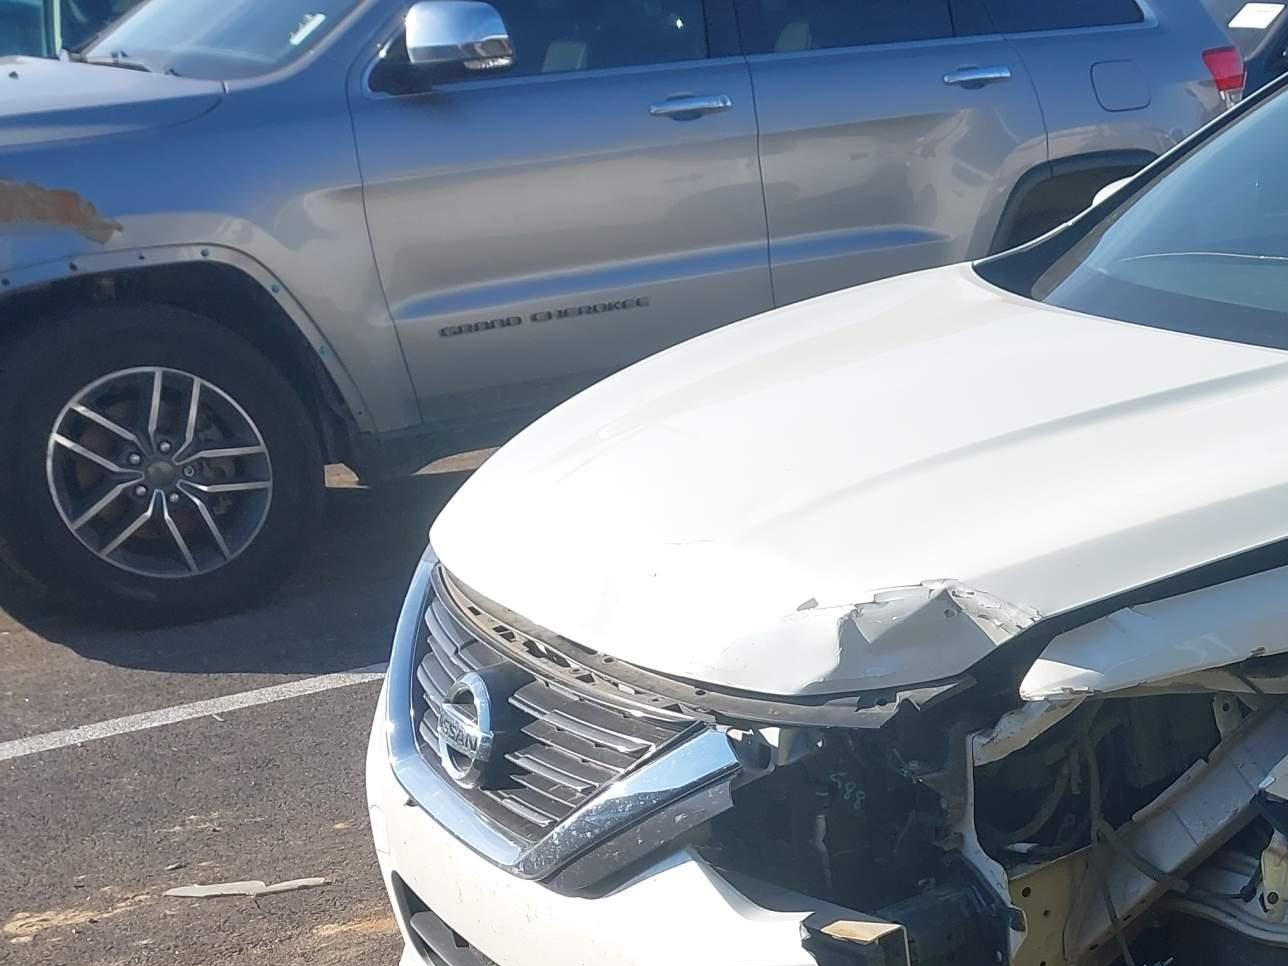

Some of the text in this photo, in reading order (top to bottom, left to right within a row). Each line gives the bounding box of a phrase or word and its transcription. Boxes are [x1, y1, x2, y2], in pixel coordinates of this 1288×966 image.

[438, 296, 650, 338] GRAND CHEROKEE
[440, 711, 478, 751] ISSAN
